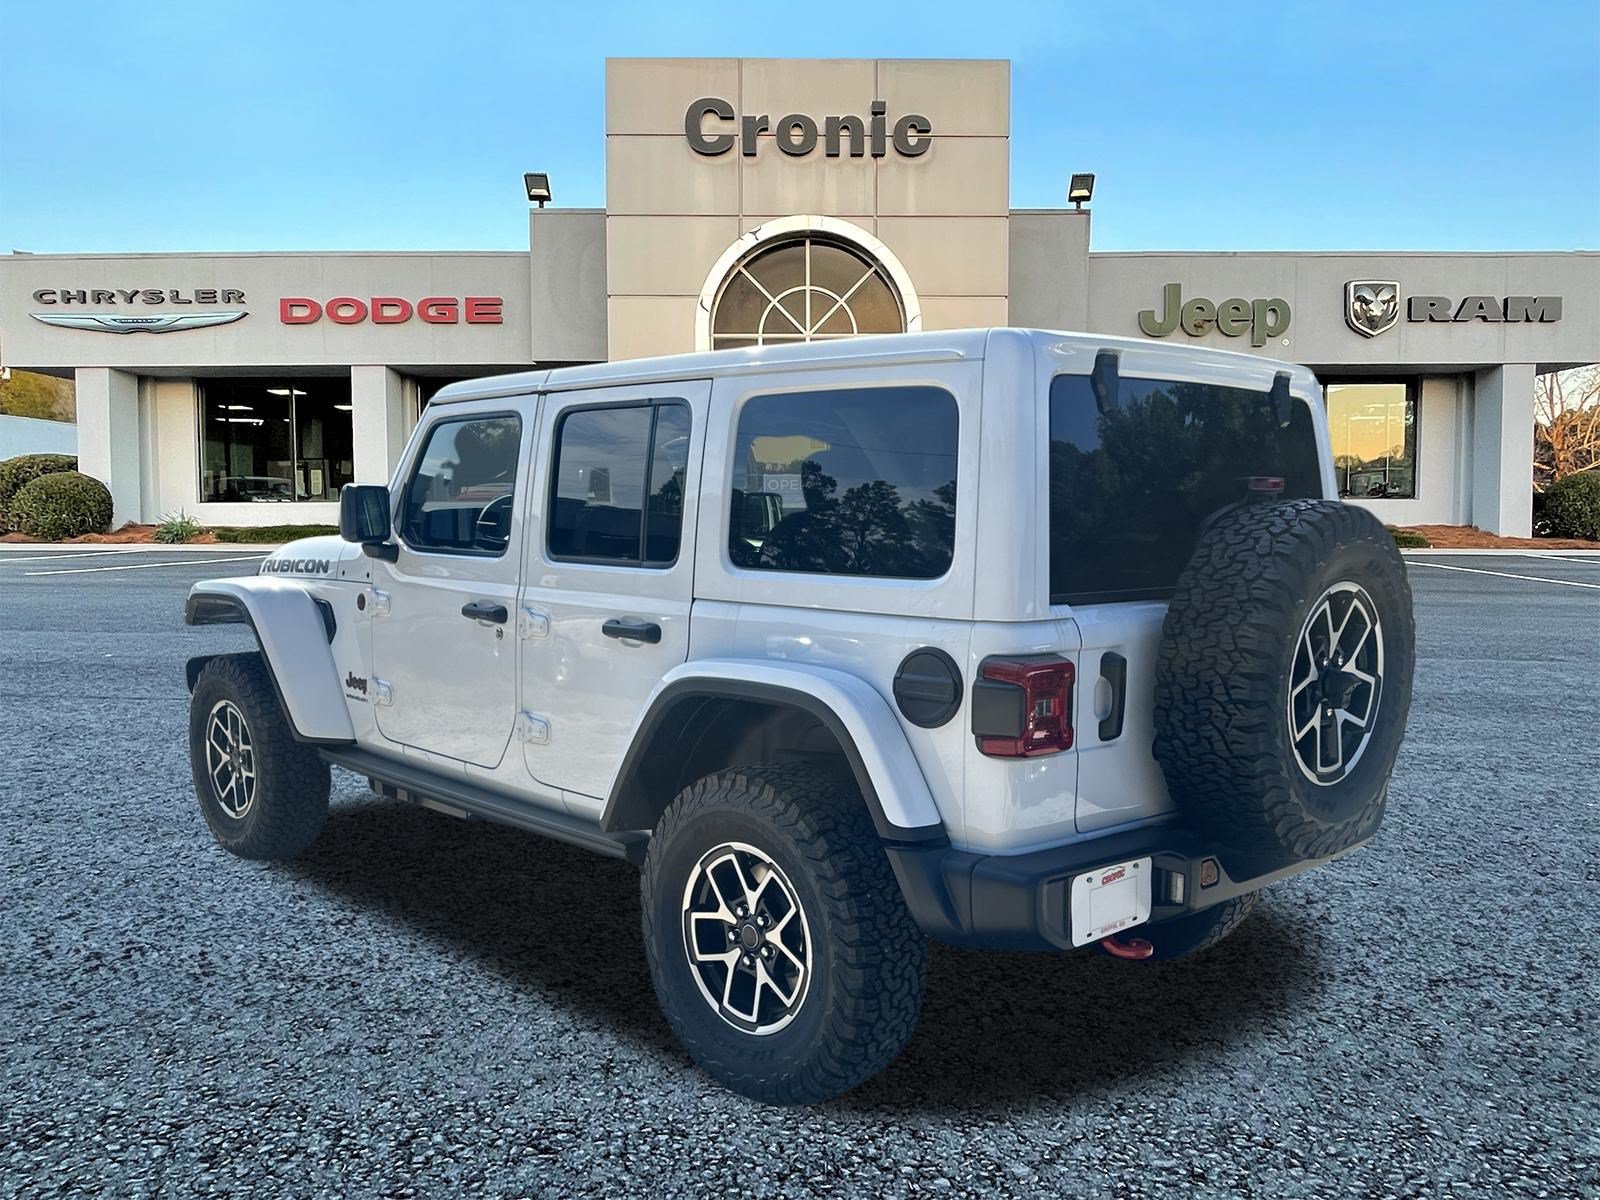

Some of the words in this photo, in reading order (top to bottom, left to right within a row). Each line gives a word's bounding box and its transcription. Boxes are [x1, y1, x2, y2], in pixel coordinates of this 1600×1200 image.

[685, 97, 932, 157] Cronic
[32, 288, 246, 305] CHRYSLER
[1407, 296, 1563, 323] RAM
[279, 297, 503, 325] DODGE
[1138, 283, 1291, 347] Jeep
[262, 559, 330, 574] RUBICON
[345, 671, 367, 695] Jeep
